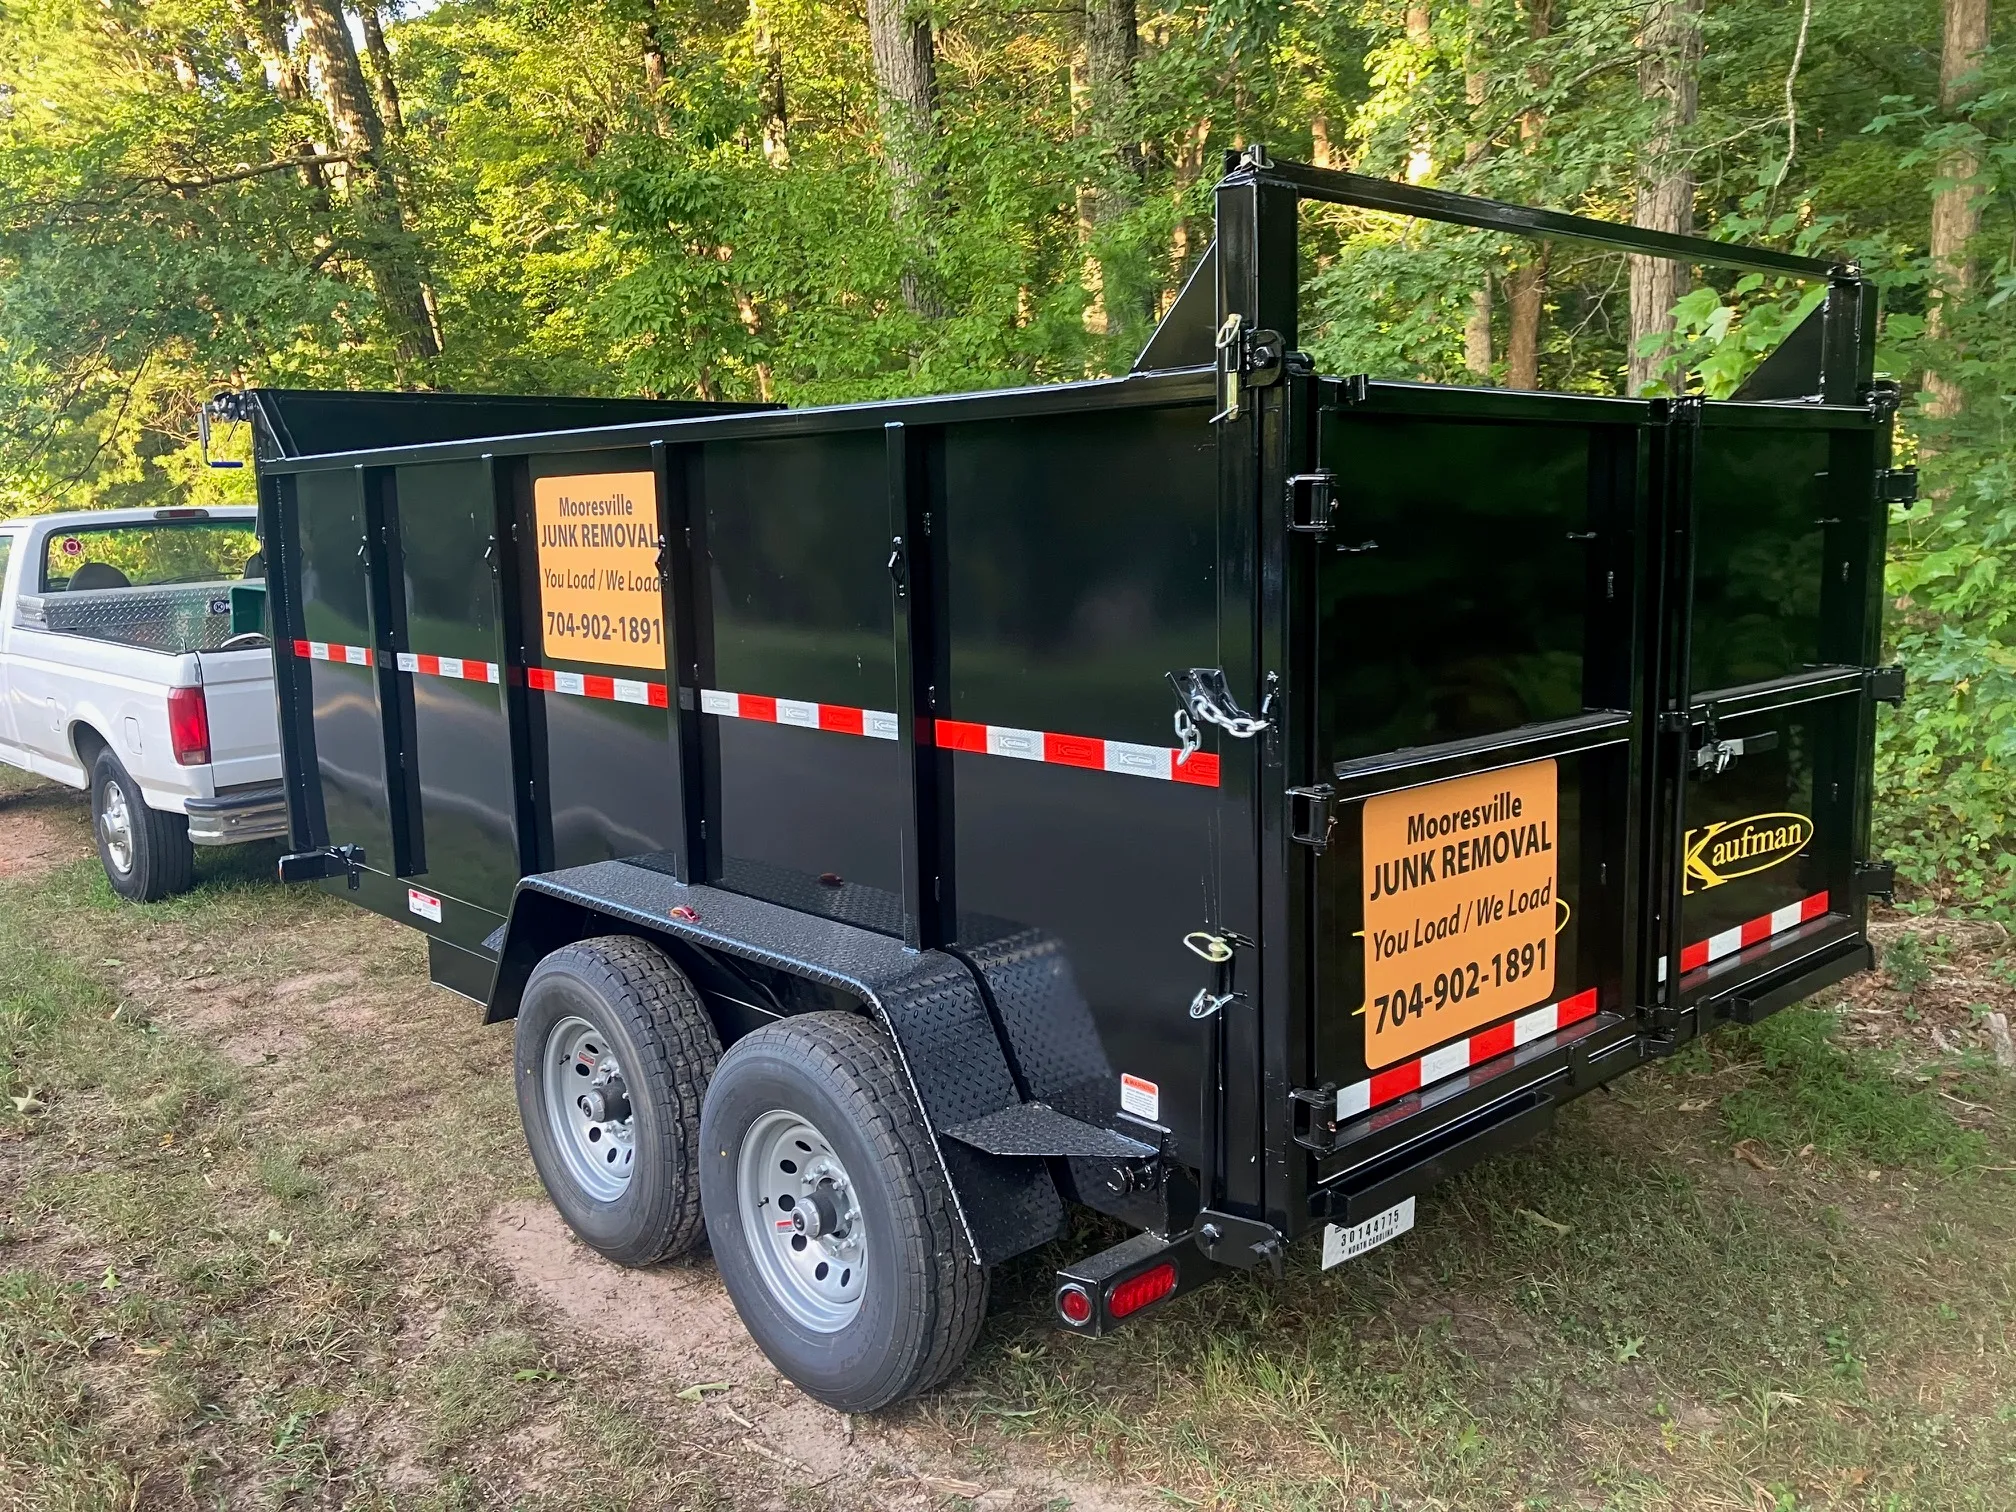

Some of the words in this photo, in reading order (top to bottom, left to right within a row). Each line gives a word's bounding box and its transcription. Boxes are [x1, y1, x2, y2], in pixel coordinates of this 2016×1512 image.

[559, 493, 633, 517] Mooresville
[542, 524, 578, 548] JUNK
[581, 523, 659, 548] REMOVAL
[544, 568, 564, 588] You
[567, 568, 596, 591] Load
[605, 570, 625, 591] We
[547, 611, 661, 645] 704-902-1891
[1407, 791, 1522, 845] Mooresville
[1370, 849, 1436, 901] JUNK
[1442, 820, 1552, 880] REMOVAL
[1682, 820, 1803, 897] Kaufman
[1373, 928, 1408, 962] You
[1414, 903, 1461, 948] Load
[1463, 900, 1474, 933] /
[1476, 894, 1504, 924] We
[1508, 876, 1552, 917] Load
[1374, 937, 1547, 1035] 704-902-1891
[1341, 1209, 1399, 1247] 30144775
[1348, 1241, 1367, 1255] NORTH
